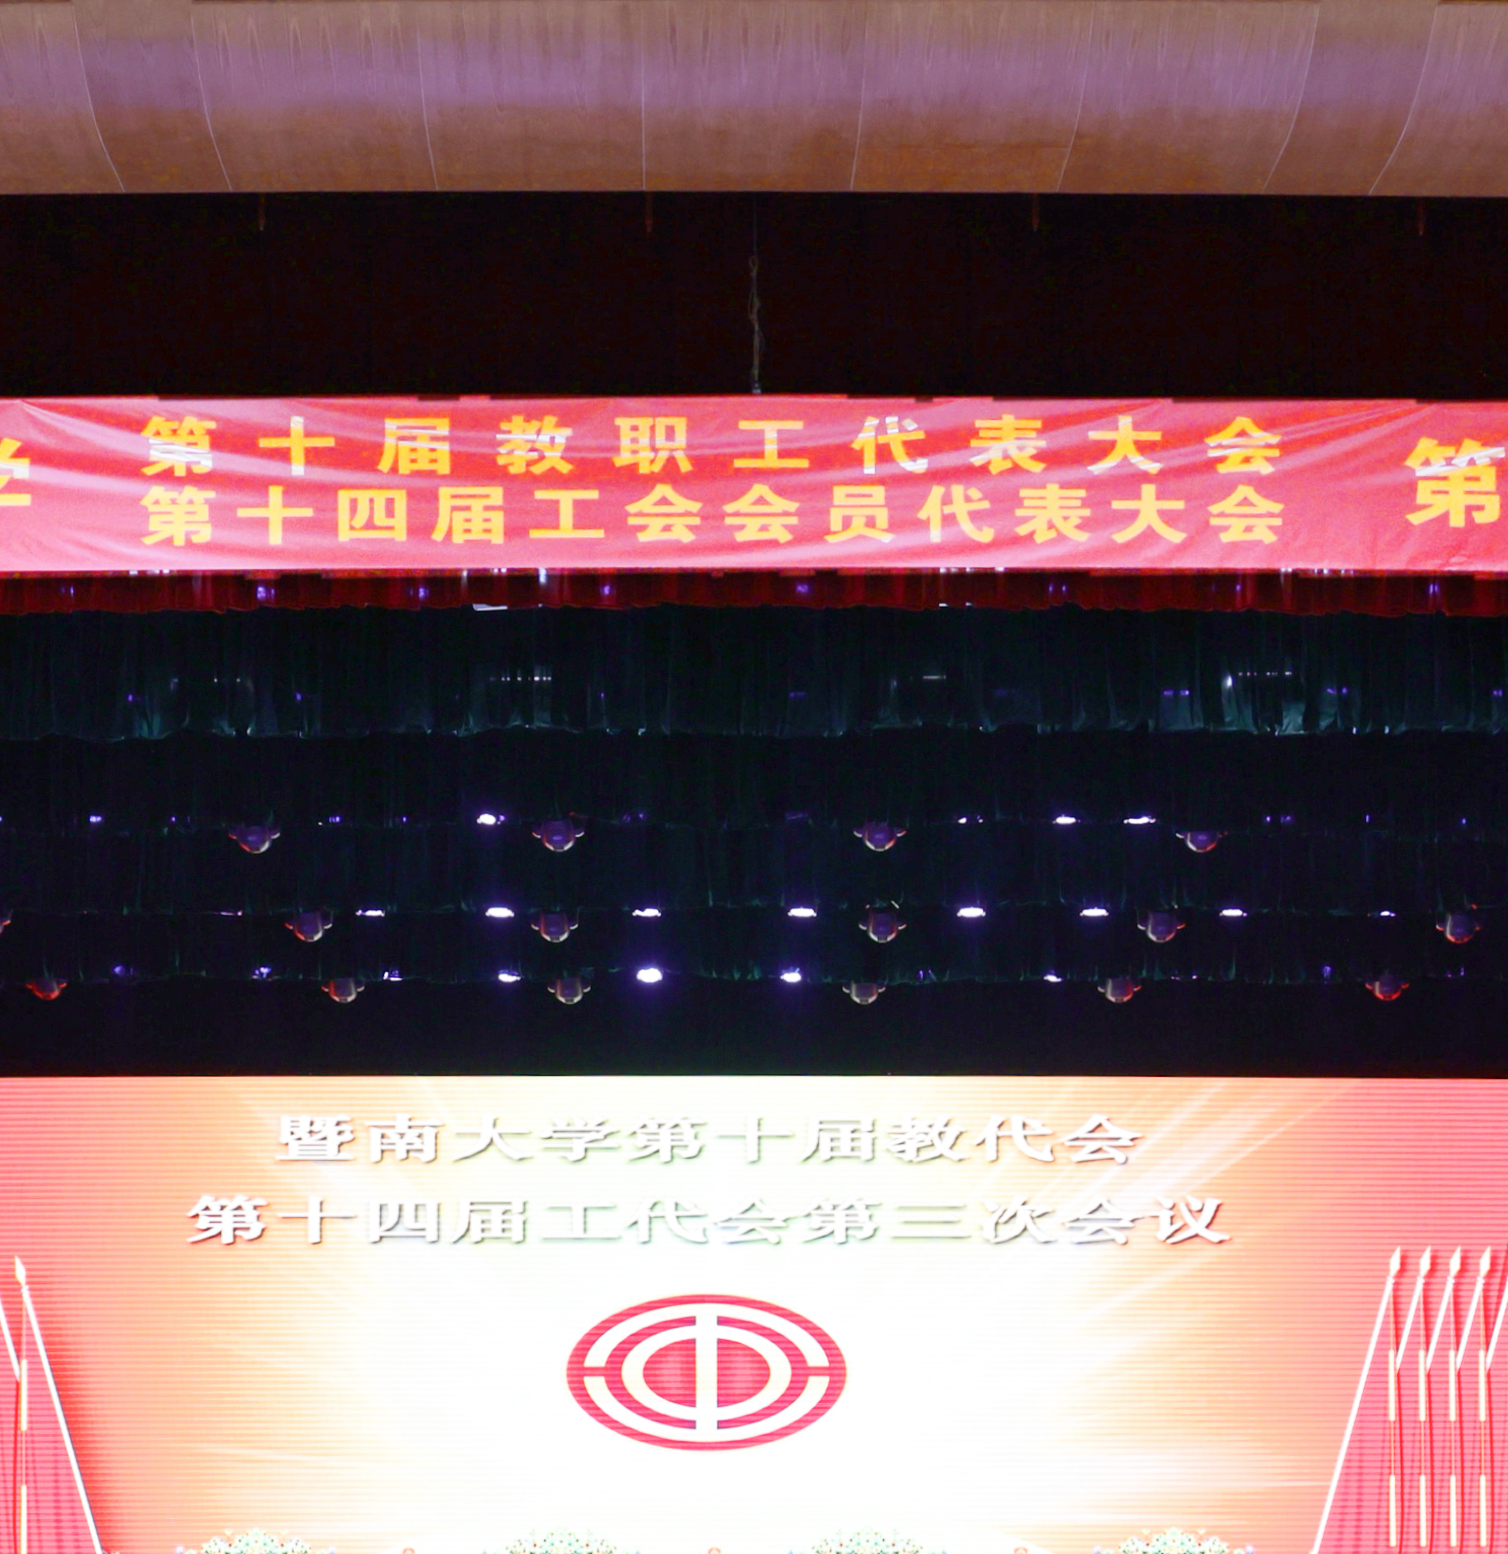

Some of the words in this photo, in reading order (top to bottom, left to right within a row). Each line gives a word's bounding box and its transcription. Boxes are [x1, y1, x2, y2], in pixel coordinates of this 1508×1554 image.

[140, 414, 1285, 476] 第十届教职工代表大会
[140, 483, 1285, 548] 第十四届工会会员代表大会
[276, 1114, 1143, 1166] 暨南大学第十届教代会
[187, 1194, 1230, 1248] 第十四届工代会第三次会议
